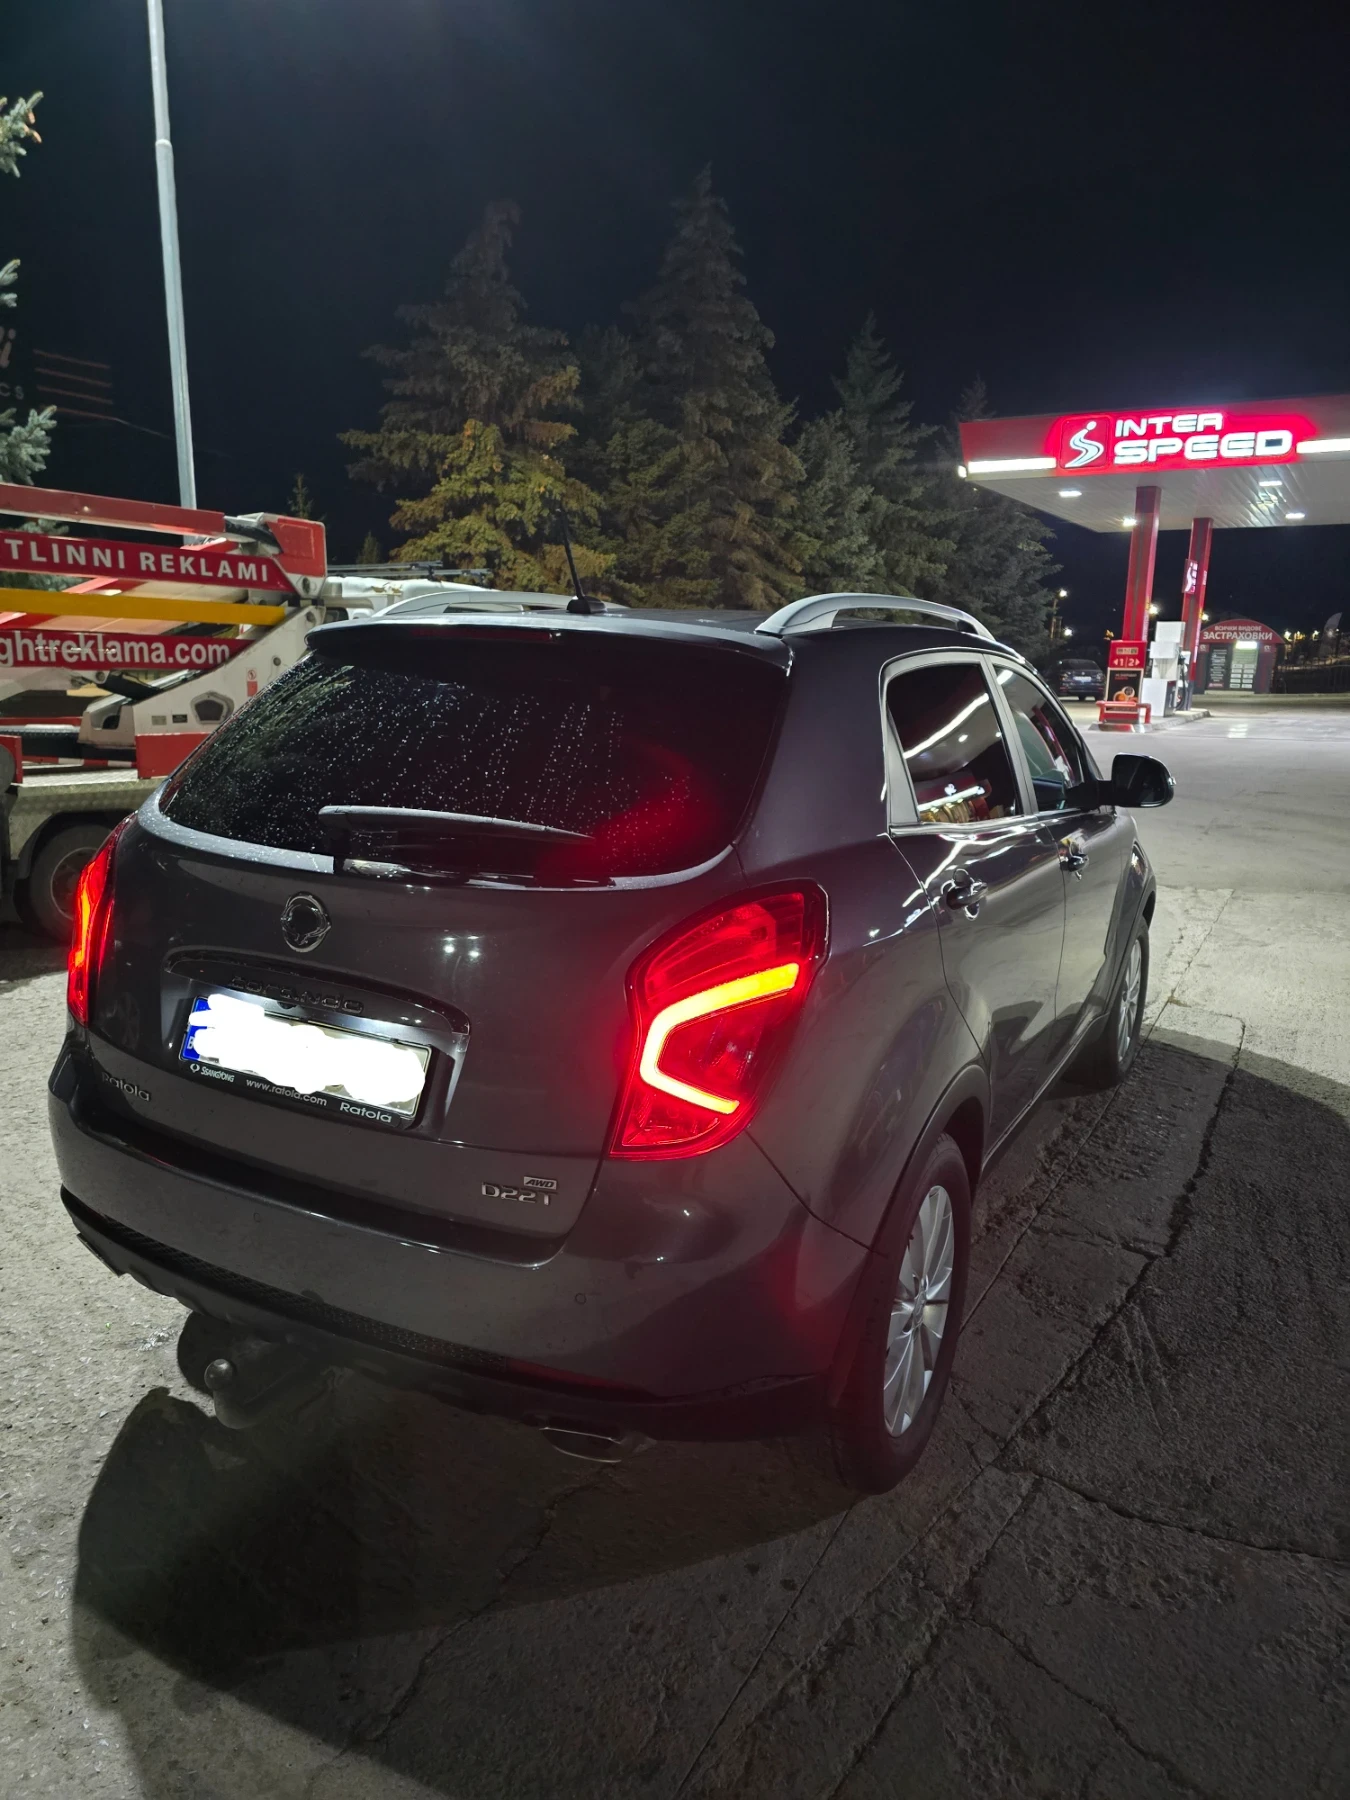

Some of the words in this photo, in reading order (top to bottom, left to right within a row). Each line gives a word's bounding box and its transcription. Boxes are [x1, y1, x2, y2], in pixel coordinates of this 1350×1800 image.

[1115, 412, 1223, 437] INTER
[1114, 430, 1293, 464] SPEED
[4, 538, 125, 570] TLINNI
[140, 552, 268, 582] REKLAMI
[1203, 632, 1273, 640] ЗАСТРАХОВКИ
[246, 1078, 328, 1107] www.ratola.com
[340, 1101, 393, 1124] Ratola
[481, 1181, 559, 1206] D22T
[525, 1179, 555, 1188] AWD
